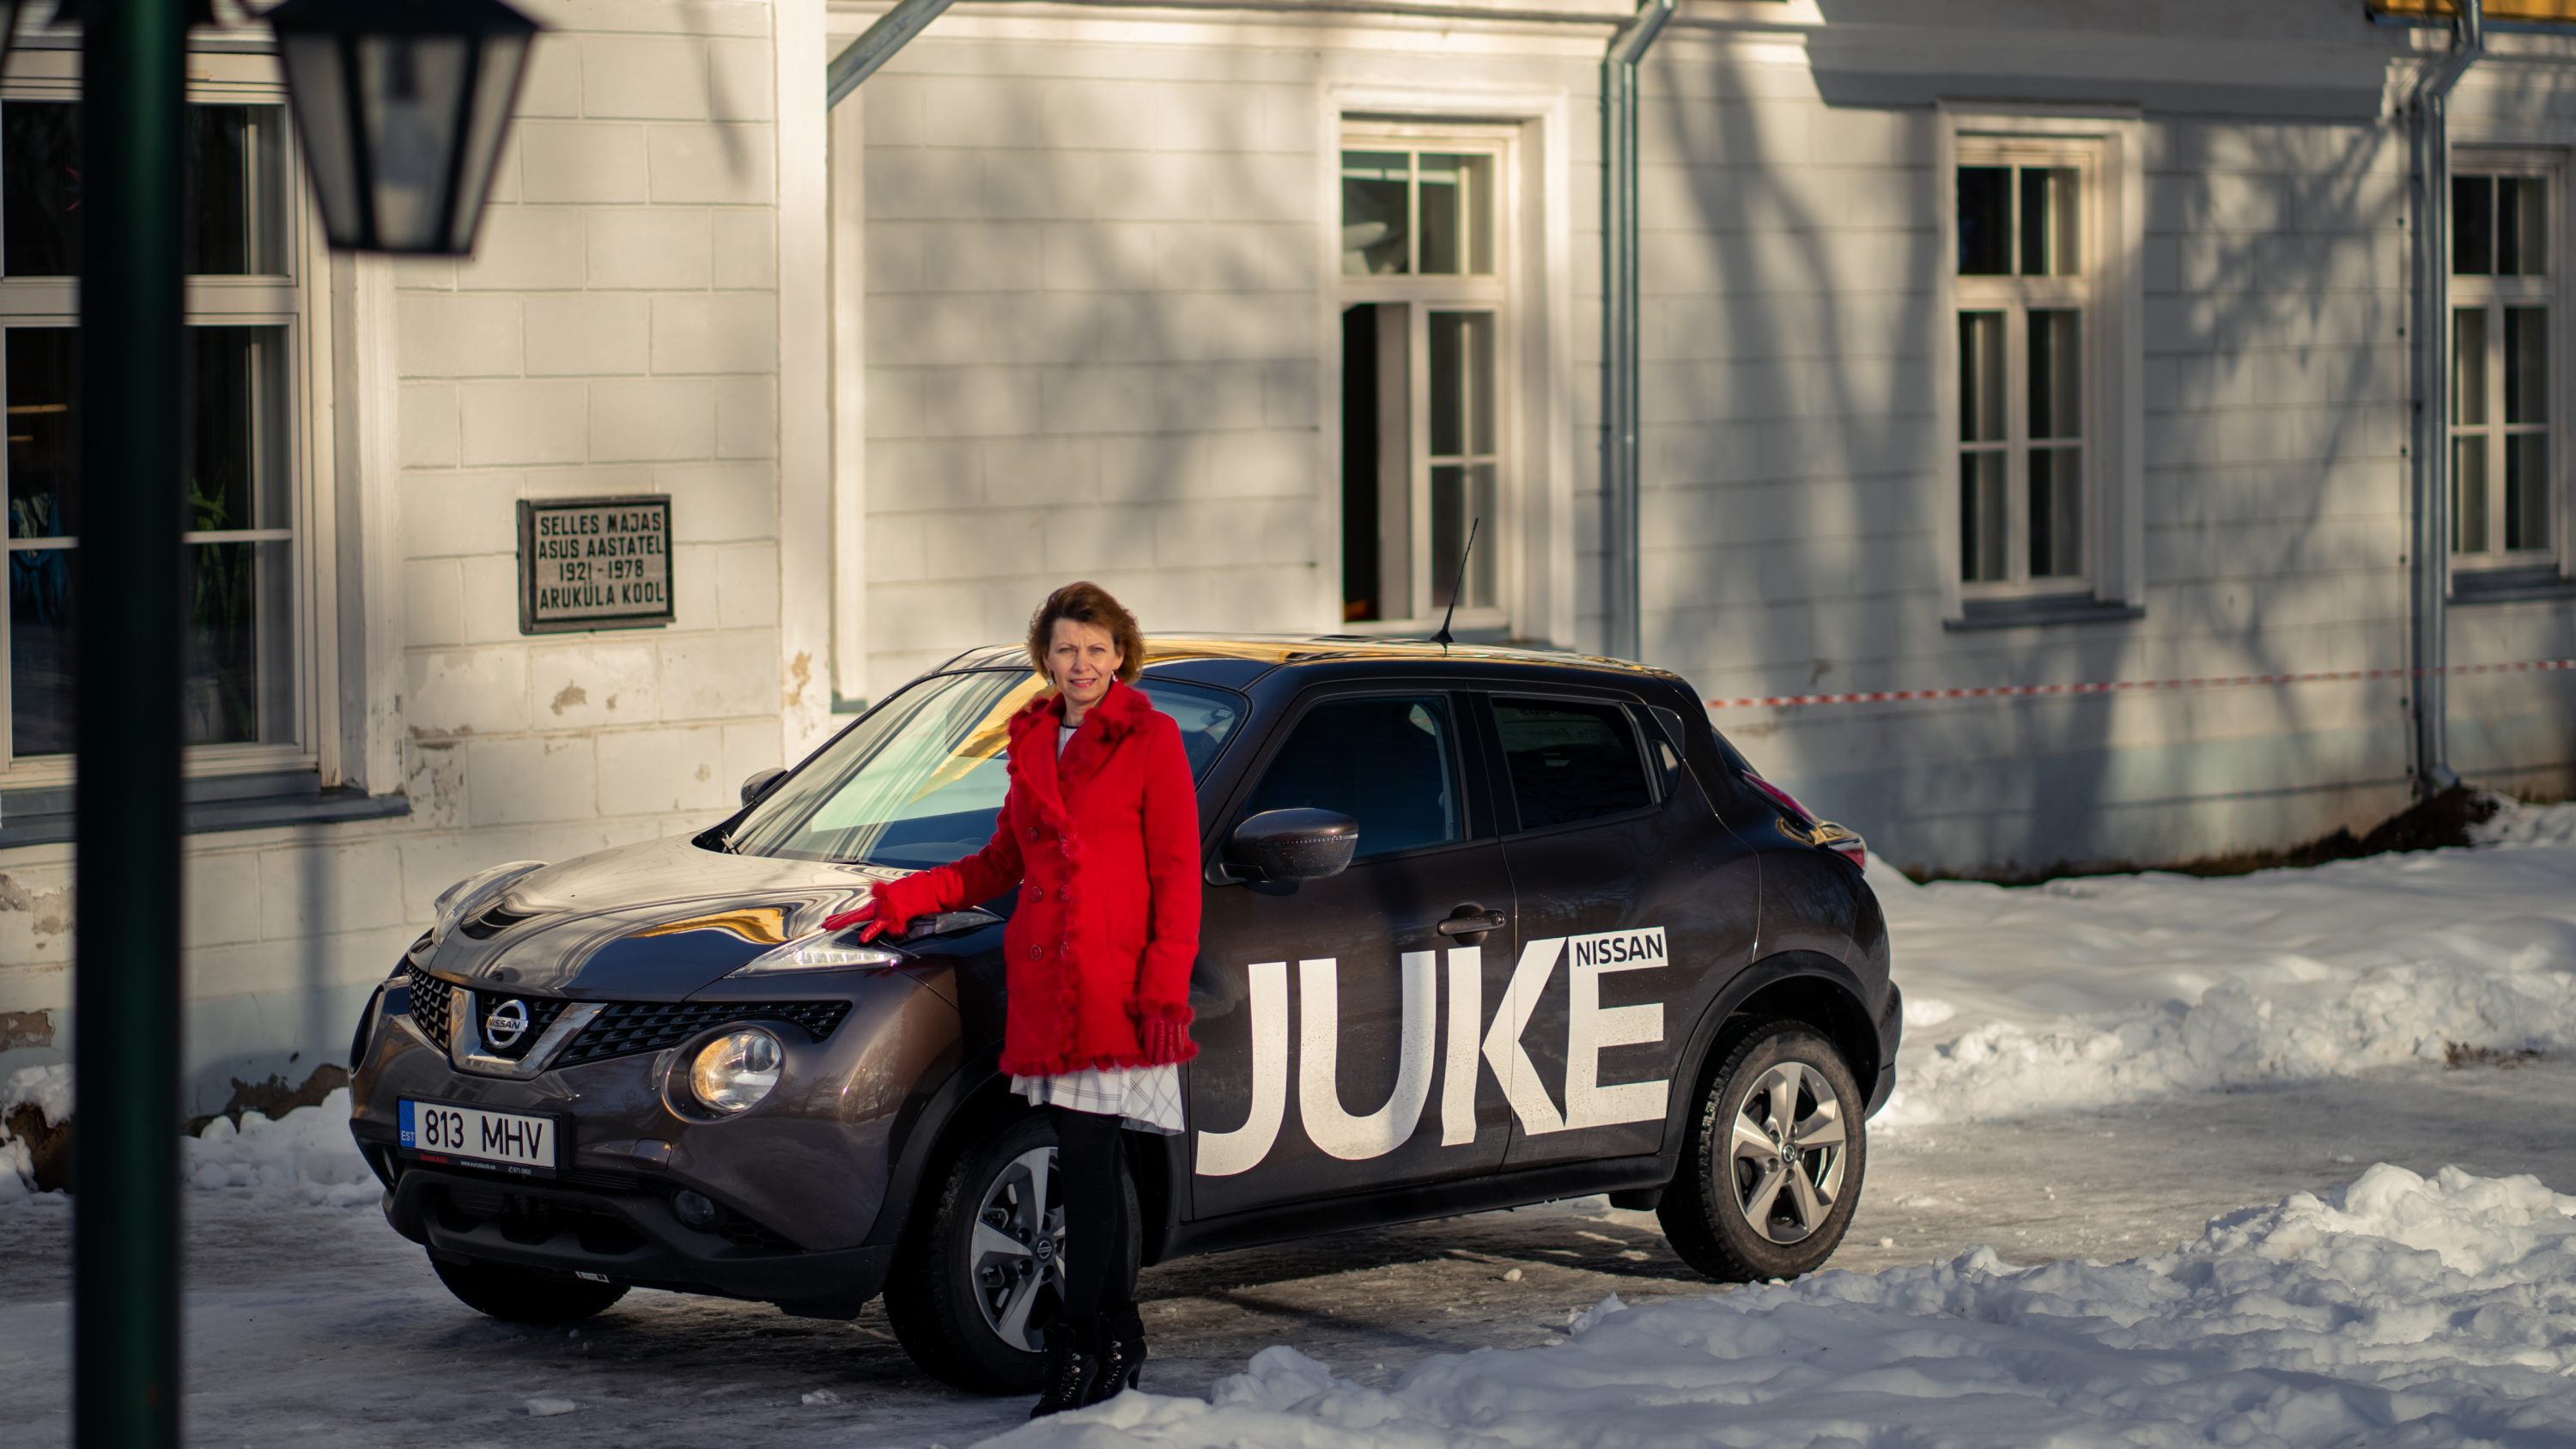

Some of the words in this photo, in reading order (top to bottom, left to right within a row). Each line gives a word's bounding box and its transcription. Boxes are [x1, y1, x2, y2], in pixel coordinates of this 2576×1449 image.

[541, 514, 599, 536] SELLES
[607, 513, 661, 533] MAJAS
[538, 539, 579, 559] ASUS
[587, 535, 664, 557] AASTATEL
[540, 581, 616, 610] ARUKÜLA
[623, 581, 664, 605] KOOL
[1576, 934, 1664, 967] NISSAN
[487, 1018, 520, 1030] NISSAN
[1195, 927, 1668, 1177] JUKE
[401, 1130, 415, 1142] EST
[425, 1109, 465, 1149] 813
[481, 1115, 543, 1160] MHV
